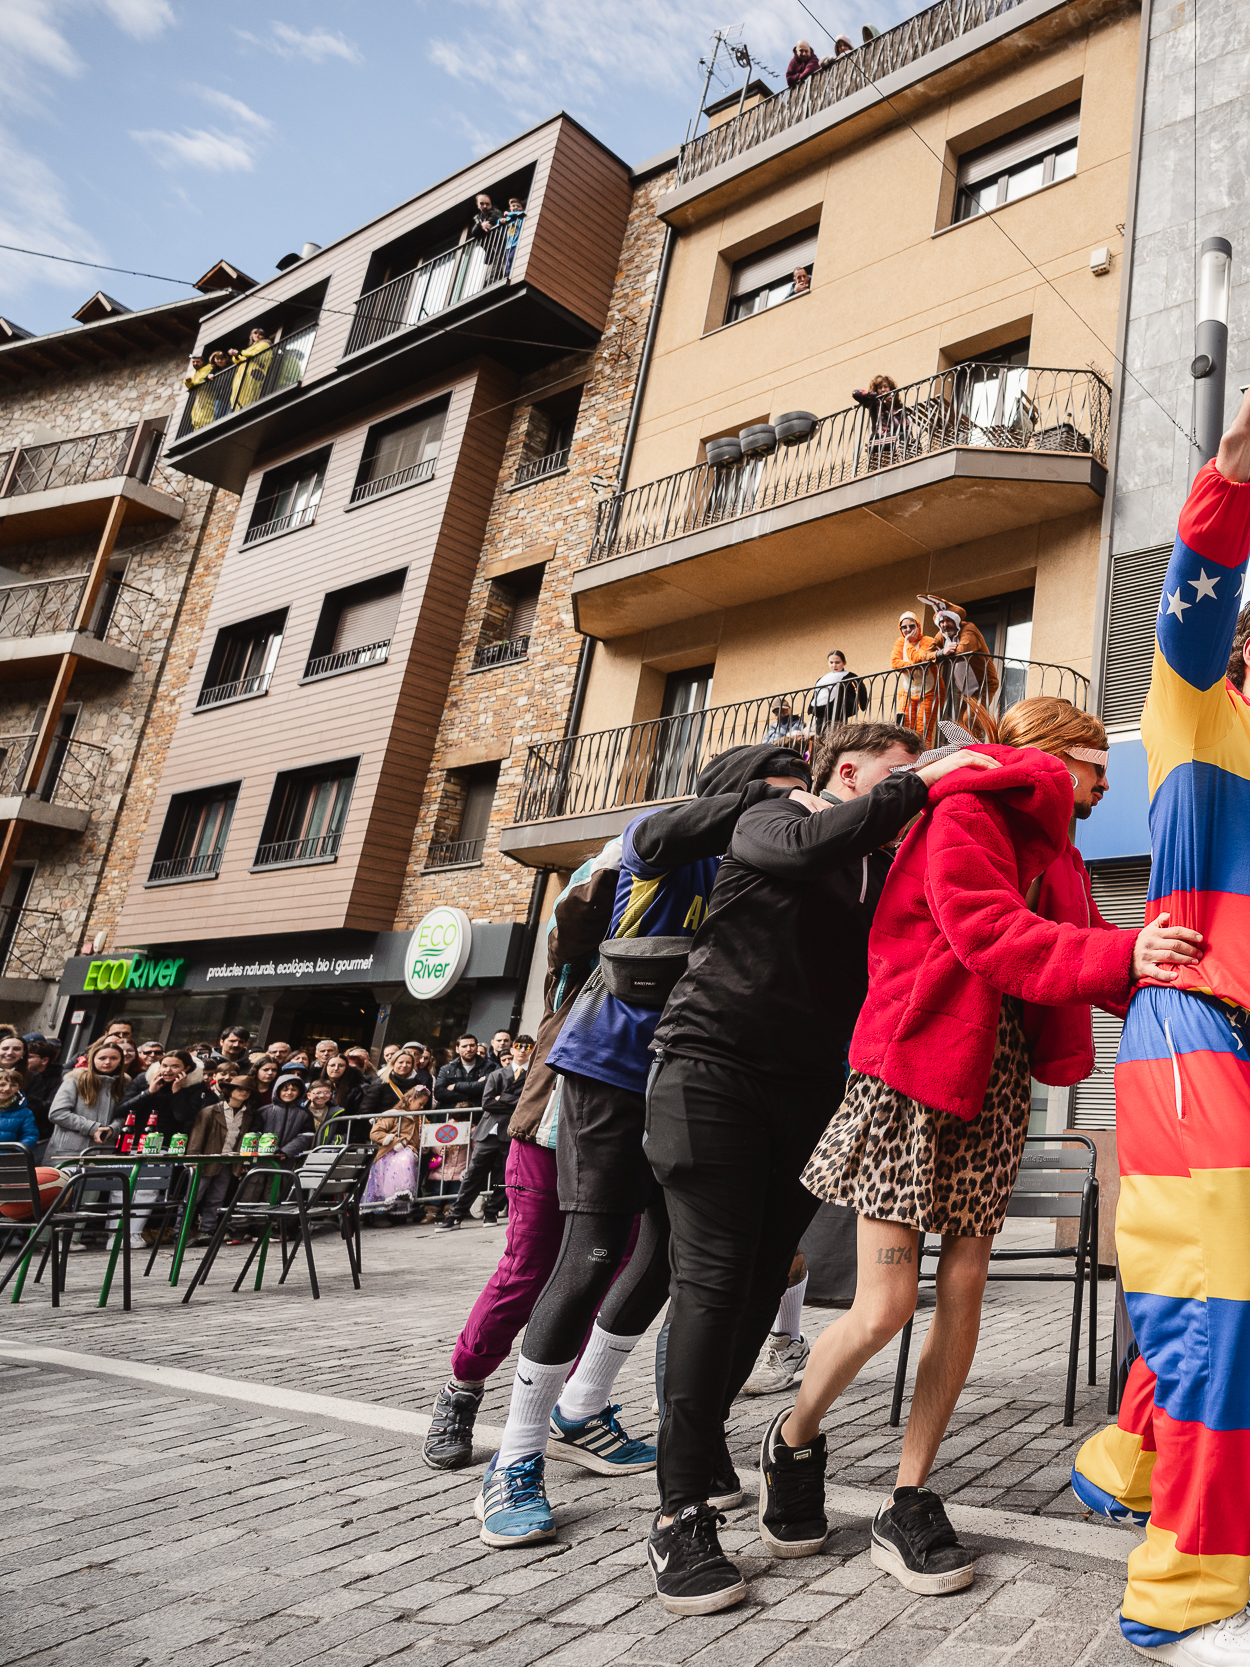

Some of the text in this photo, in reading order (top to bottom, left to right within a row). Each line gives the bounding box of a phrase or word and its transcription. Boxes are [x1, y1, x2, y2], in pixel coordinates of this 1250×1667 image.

[418, 924, 457, 947] ECO
[83, 958, 127, 991] ECO
[206, 963, 243, 981] productes
[315, 957, 330, 972] bio
[330, 958, 336, 971] i
[335, 954, 374, 975] gourmet
[411, 958, 450, 979] River
[875, 1246, 912, 1265] 1974
